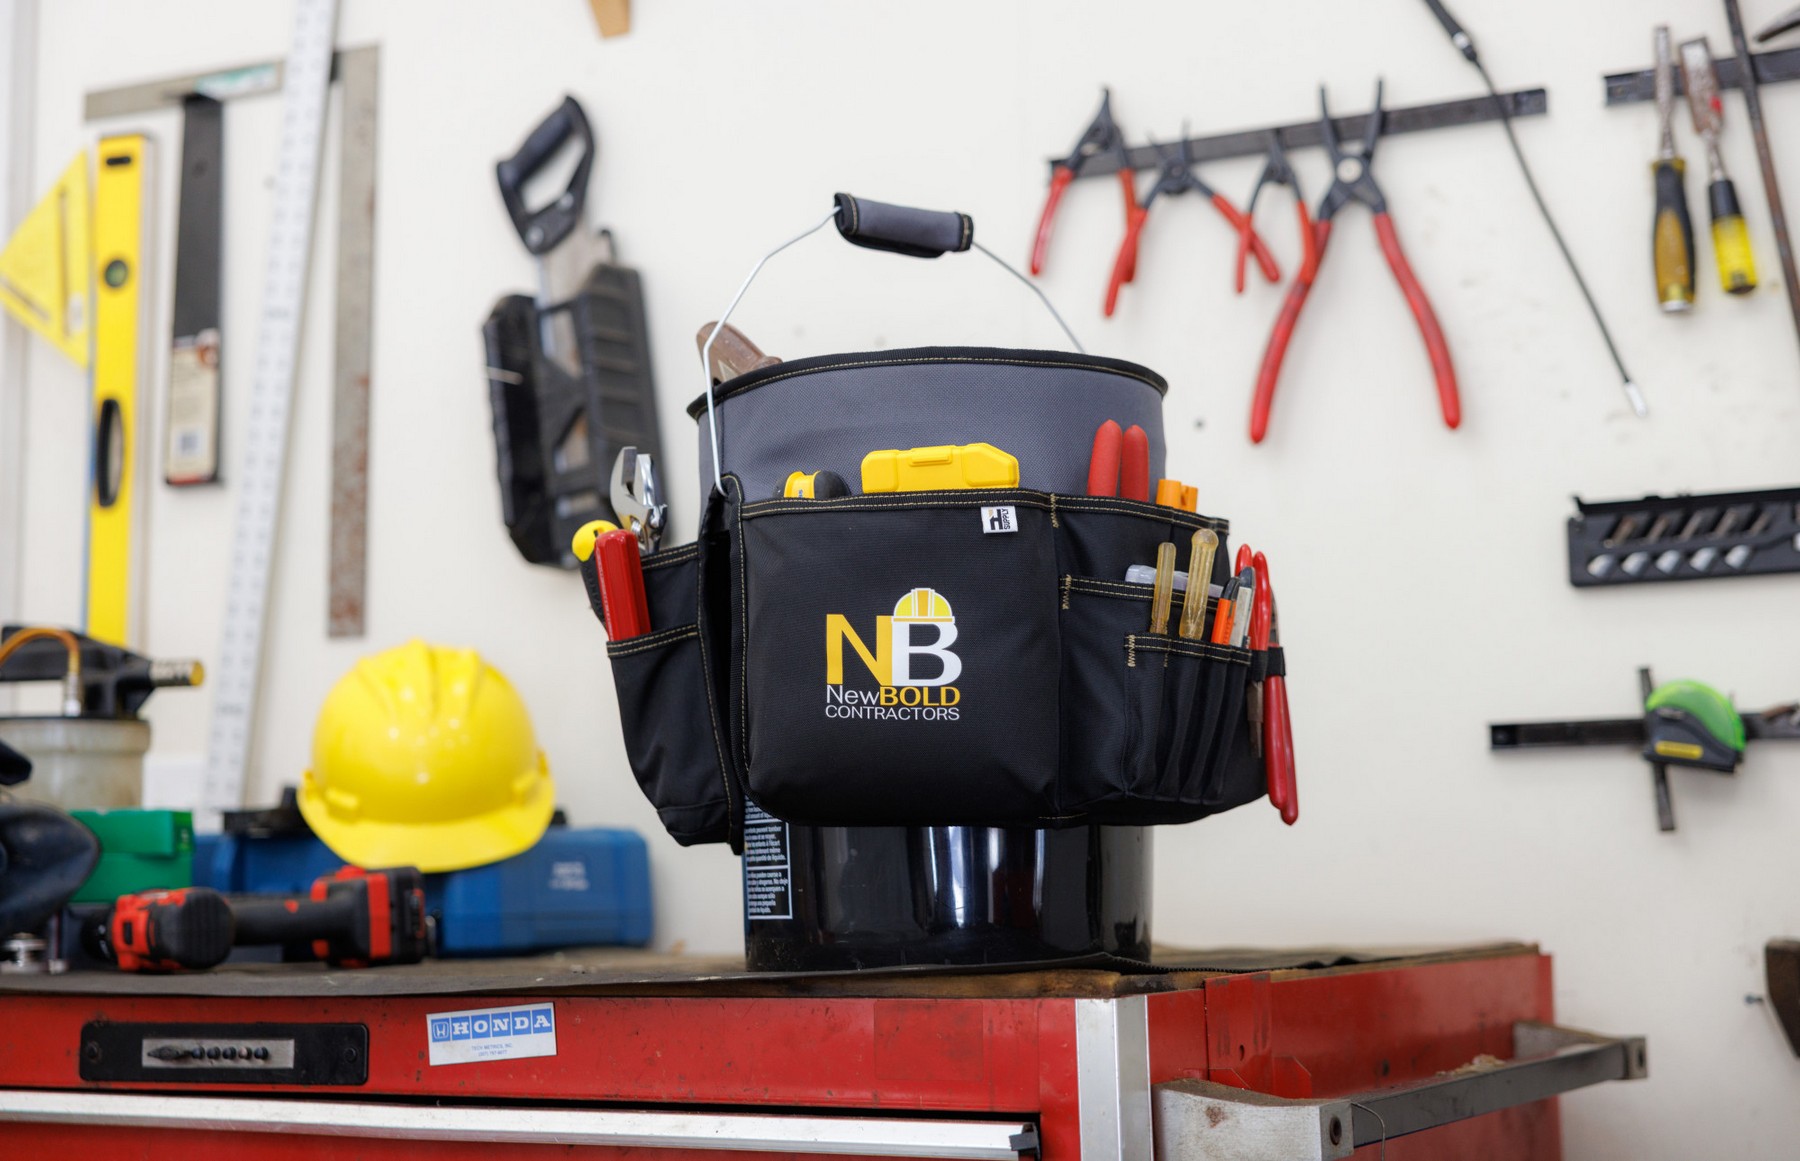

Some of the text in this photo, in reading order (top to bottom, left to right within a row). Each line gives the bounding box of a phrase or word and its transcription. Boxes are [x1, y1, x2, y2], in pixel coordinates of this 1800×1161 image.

[1001, 507, 1011, 530] SUPPLY
[825, 704, 961, 721] CONTRACTORS
[452, 1015, 551, 1035] HONDA
